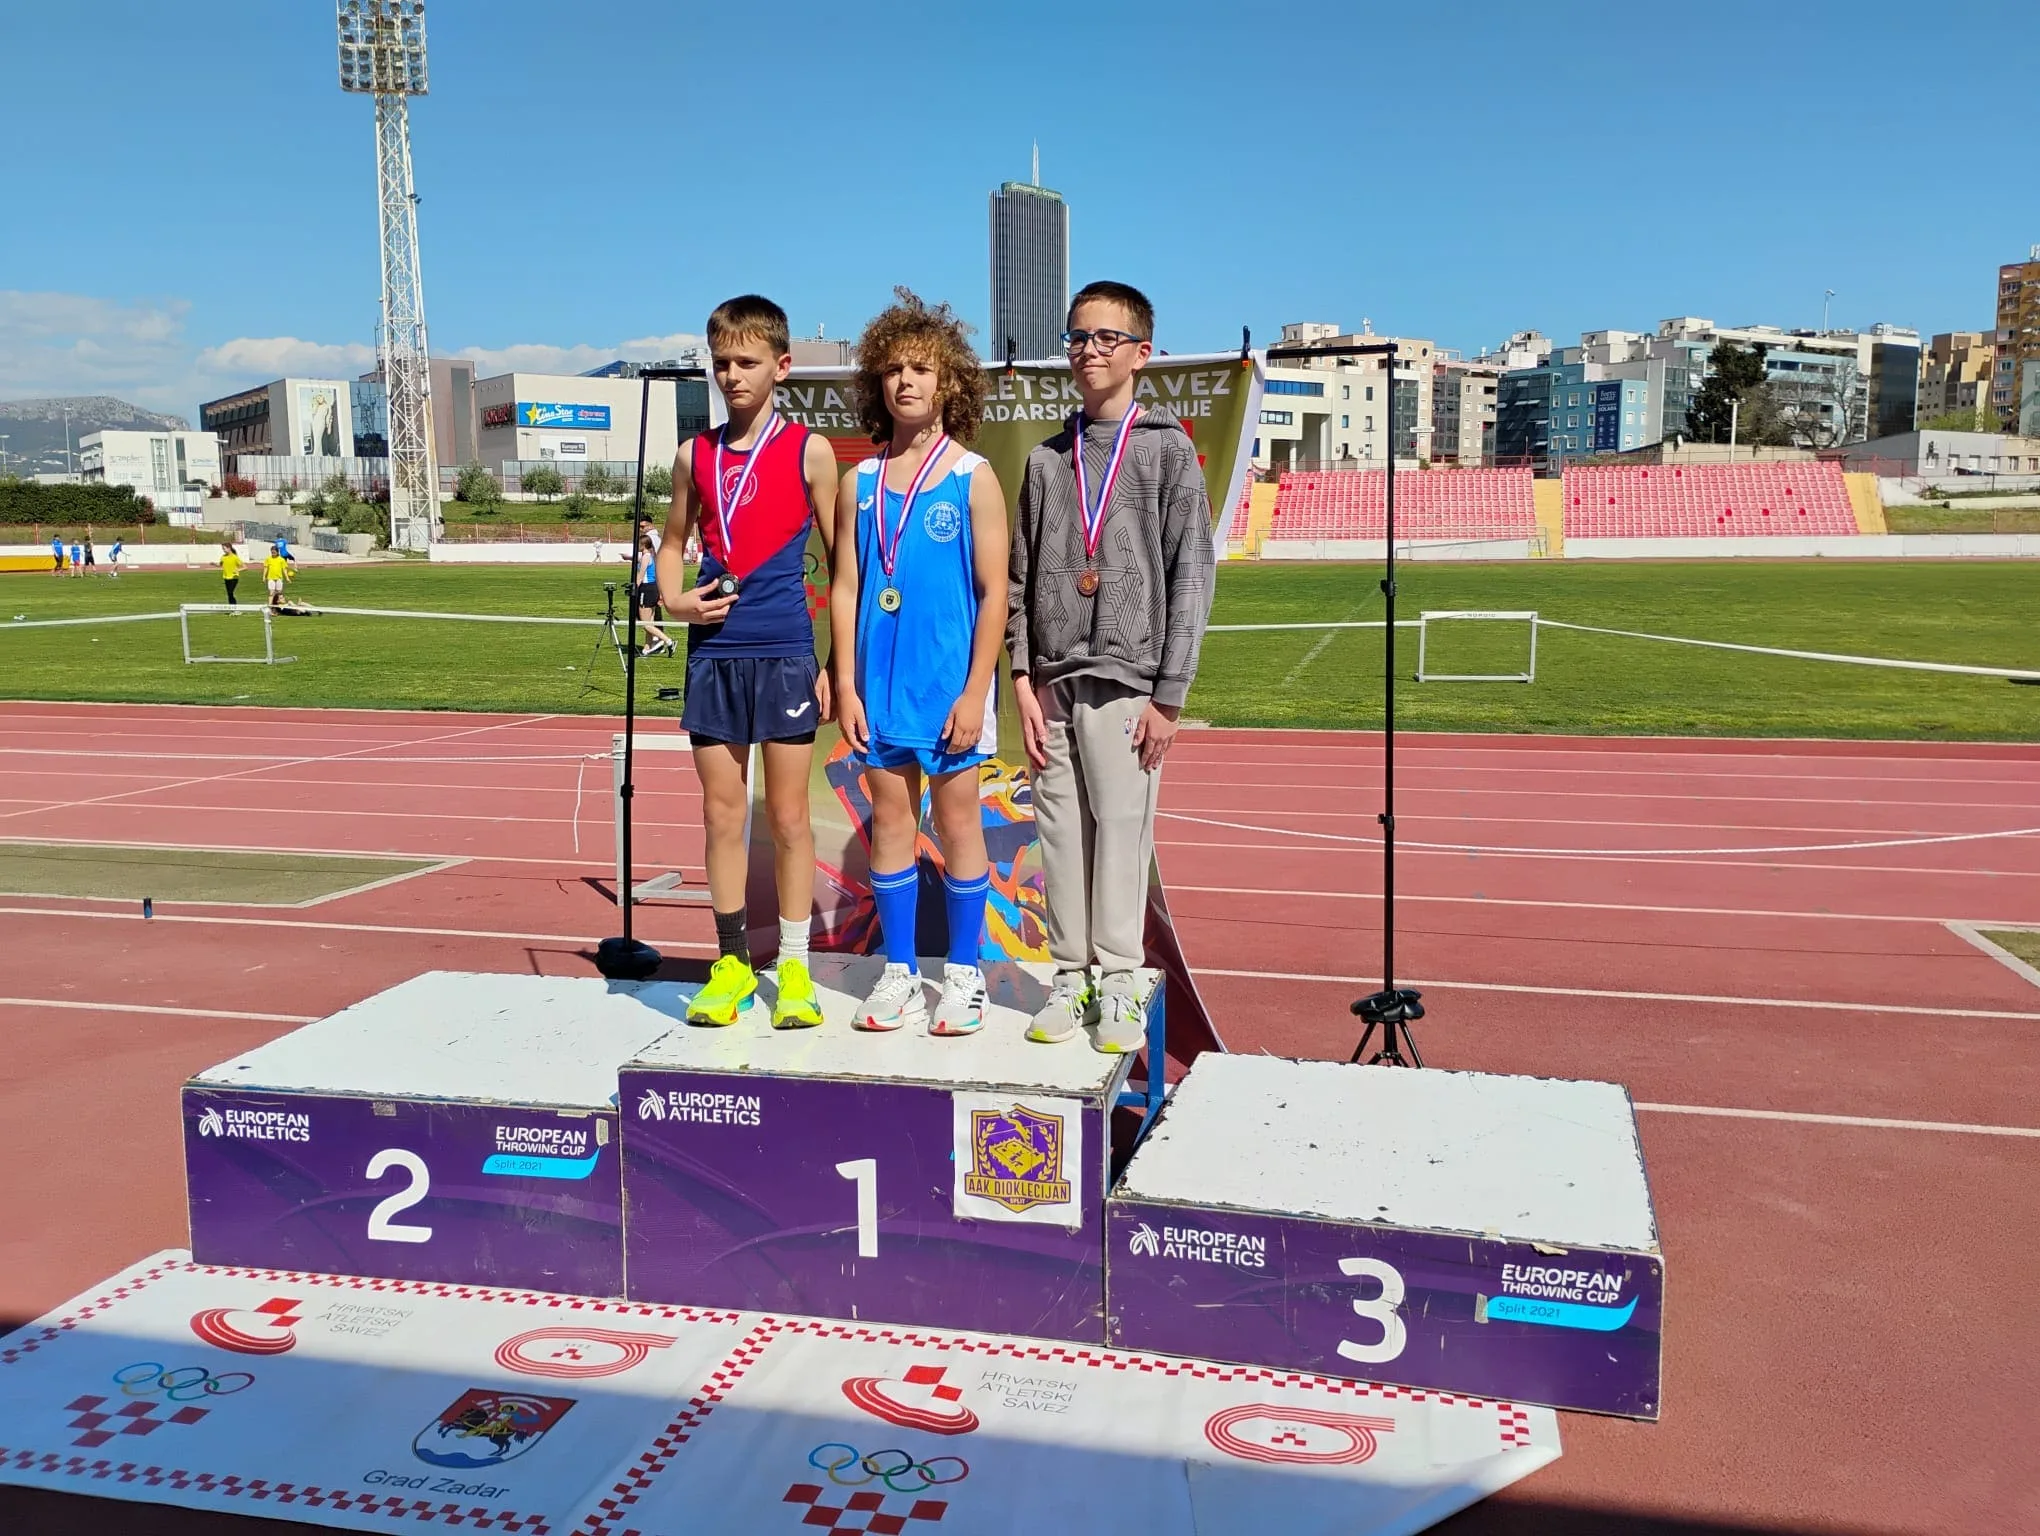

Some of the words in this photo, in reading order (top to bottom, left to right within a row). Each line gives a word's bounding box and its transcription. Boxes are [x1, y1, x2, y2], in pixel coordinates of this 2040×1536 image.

[1134, 369, 1231, 398] AVEZ
[668, 1092, 760, 1110] EUROPEAN
[225, 1109, 310, 1127] EUROPEAN
[669, 1107, 760, 1125] ATHLETICS
[226, 1124, 310, 1142] ATHLETICS
[496, 1126, 587, 1145] EUROPEAN
[496, 1141, 558, 1155] THROWING
[561, 1145, 586, 1156] CUP
[494, 1159, 516, 1171] Split
[519, 1160, 542, 1171] 2021
[365, 1148, 433, 1243] 2
[968, 1178, 990, 1193] AAK
[994, 1180, 1067, 1200] DIOKLECIJAN
[835, 1158, 878, 1258] 1
[1163, 1226, 1265, 1251] EUROPEAN
[1163, 1242, 1265, 1268] ATHLETICS
[1501, 1263, 1623, 1292] EUROPEAN
[1501, 1280, 1583, 1300] THROWING
[1586, 1290, 1619, 1304] CUP
[327, 1302, 414, 1320] HRVATSKI
[1336, 1257, 1407, 1364] 3
[1498, 1302, 1526, 1315] Split
[1529, 1305, 1560, 1318] 2021
[315, 1313, 401, 1327] ATLETSKI
[329, 1323, 390, 1337] SAVEZ
[981, 1370, 1078, 1391] HRVATSKI
[976, 1382, 1073, 1402] ATLETSKI
[1002, 1397, 1069, 1414] SAVEZ
[362, 1469, 430, 1490] Grad
[428, 1477, 511, 1500] Zadar
